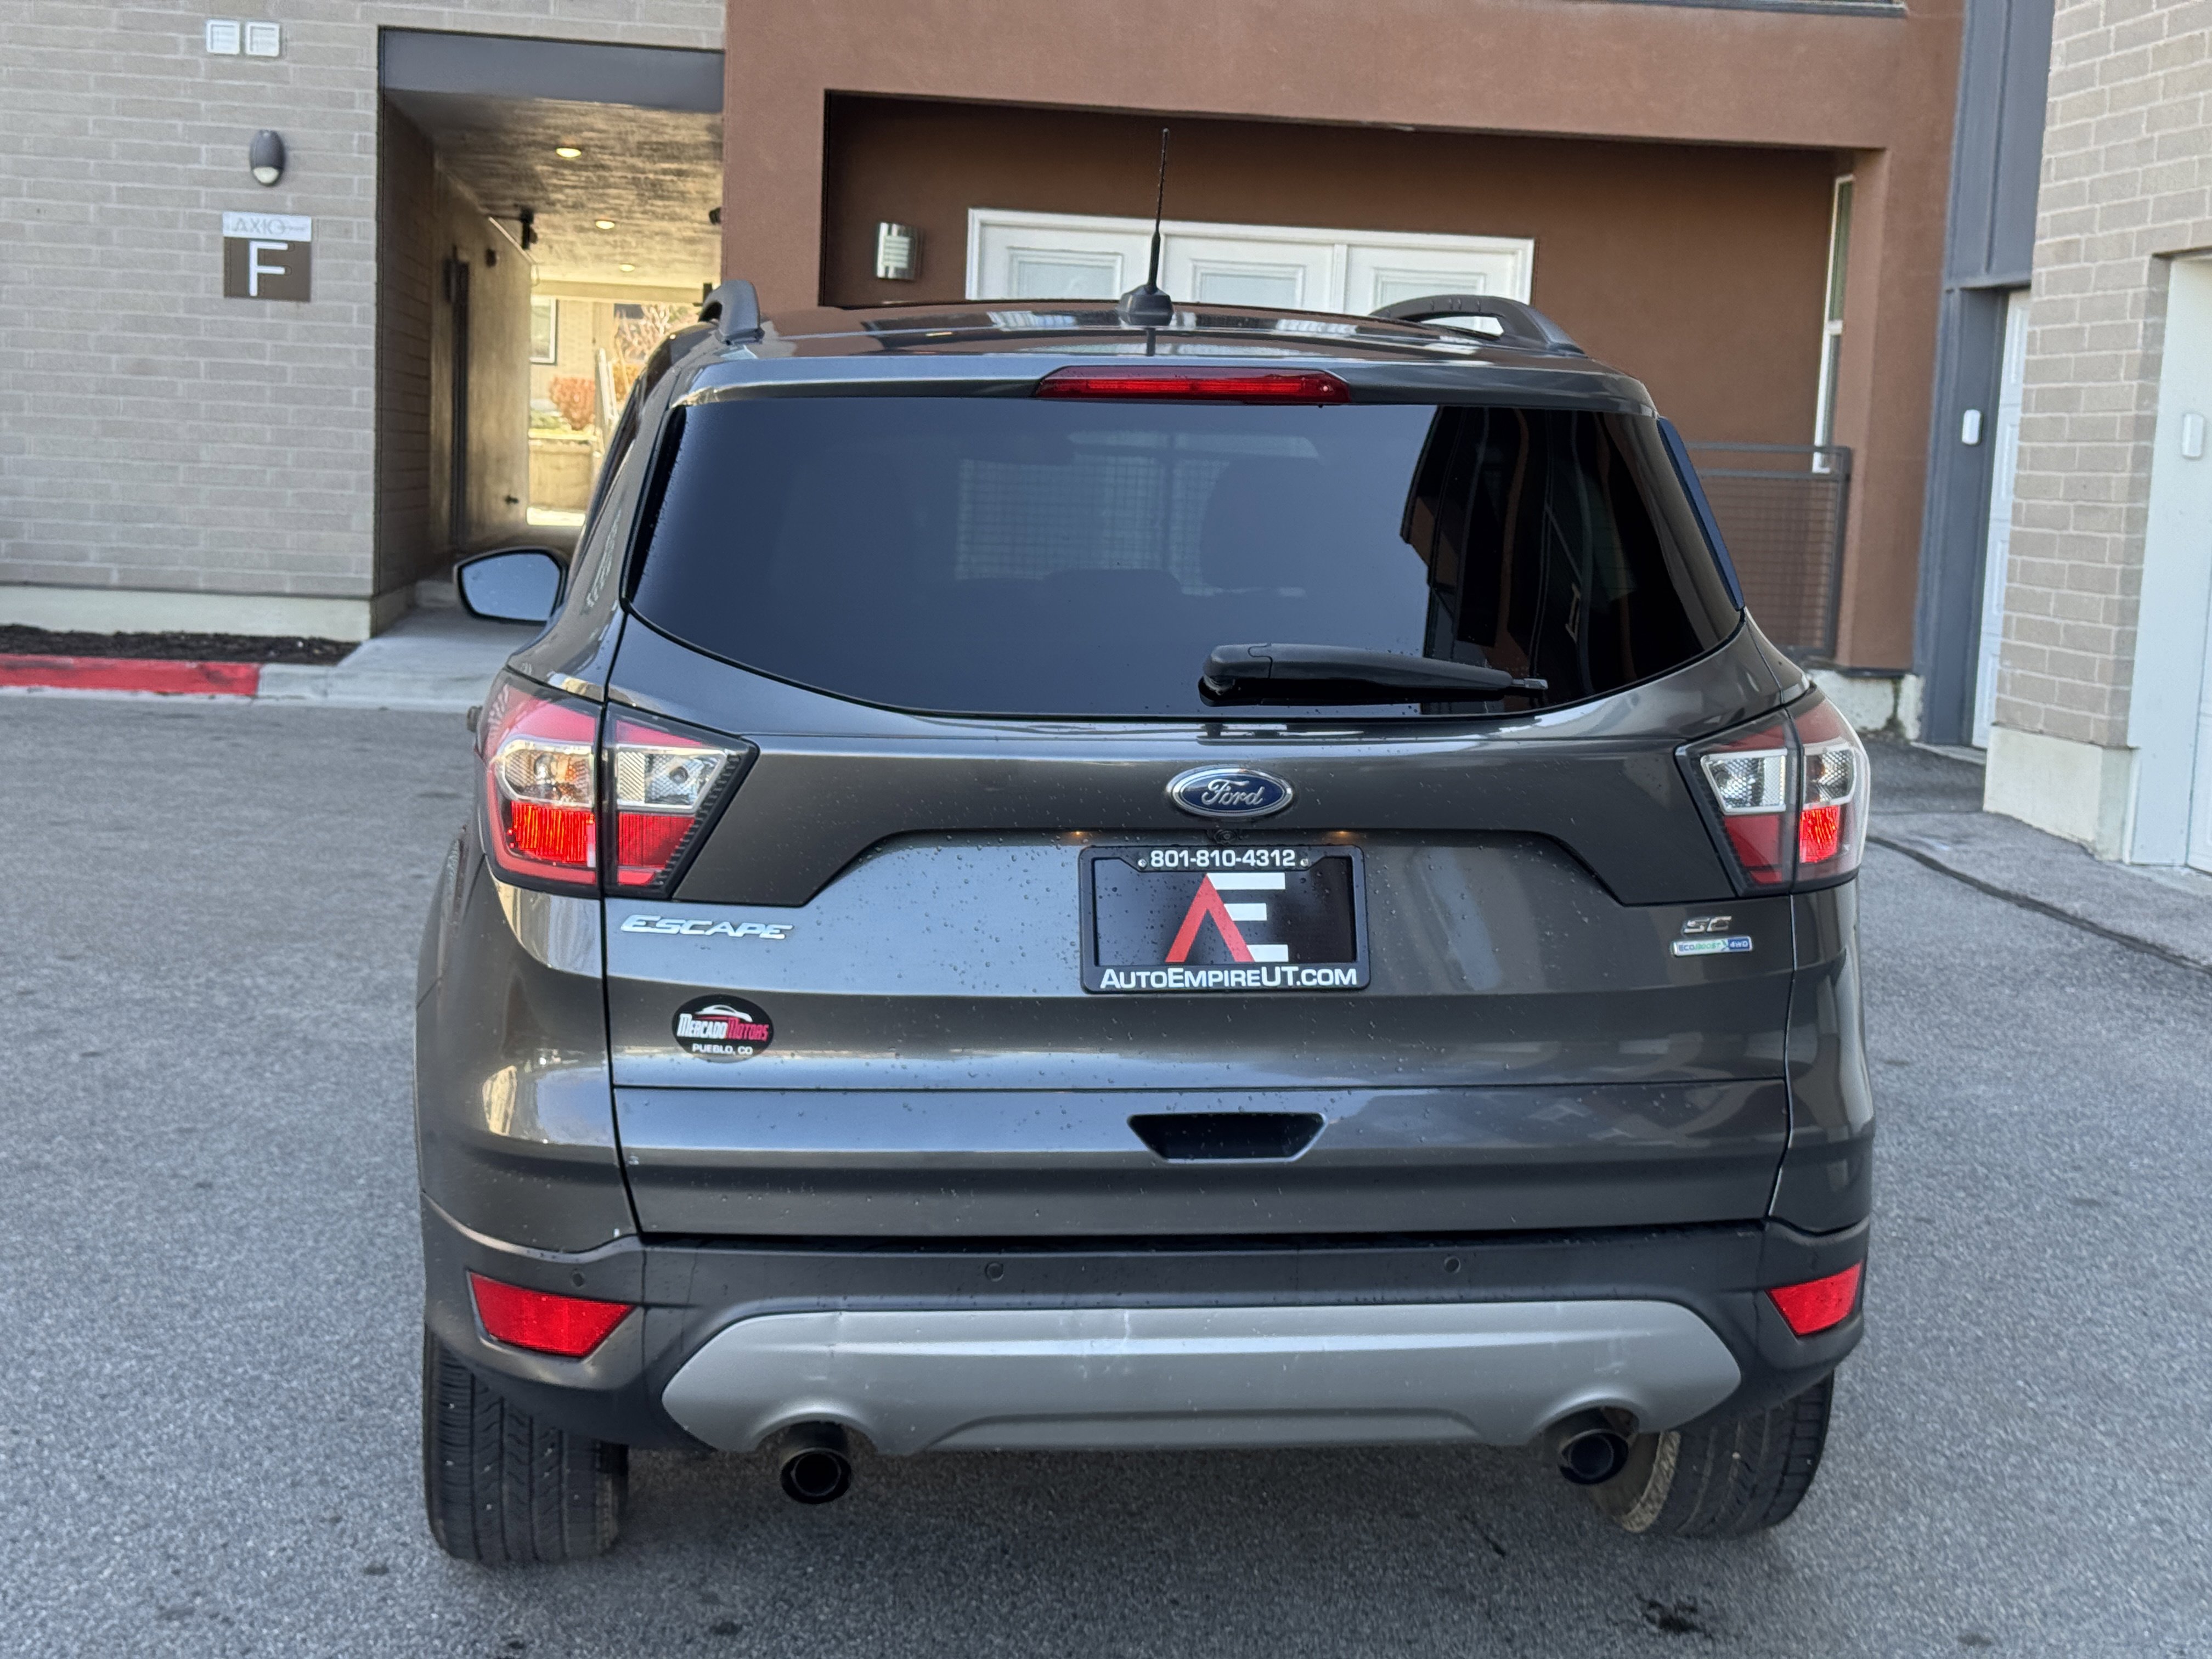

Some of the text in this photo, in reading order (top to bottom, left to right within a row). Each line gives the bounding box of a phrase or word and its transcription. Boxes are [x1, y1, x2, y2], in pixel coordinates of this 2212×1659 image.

[250, 240, 288, 296] F
[1201, 778, 1265, 806] Ford
[1150, 849, 1295, 868] 801-810-4312
[620, 914, 794, 940] ESCAPE
[692, 1043, 753, 1056] PUEBLO, CO
